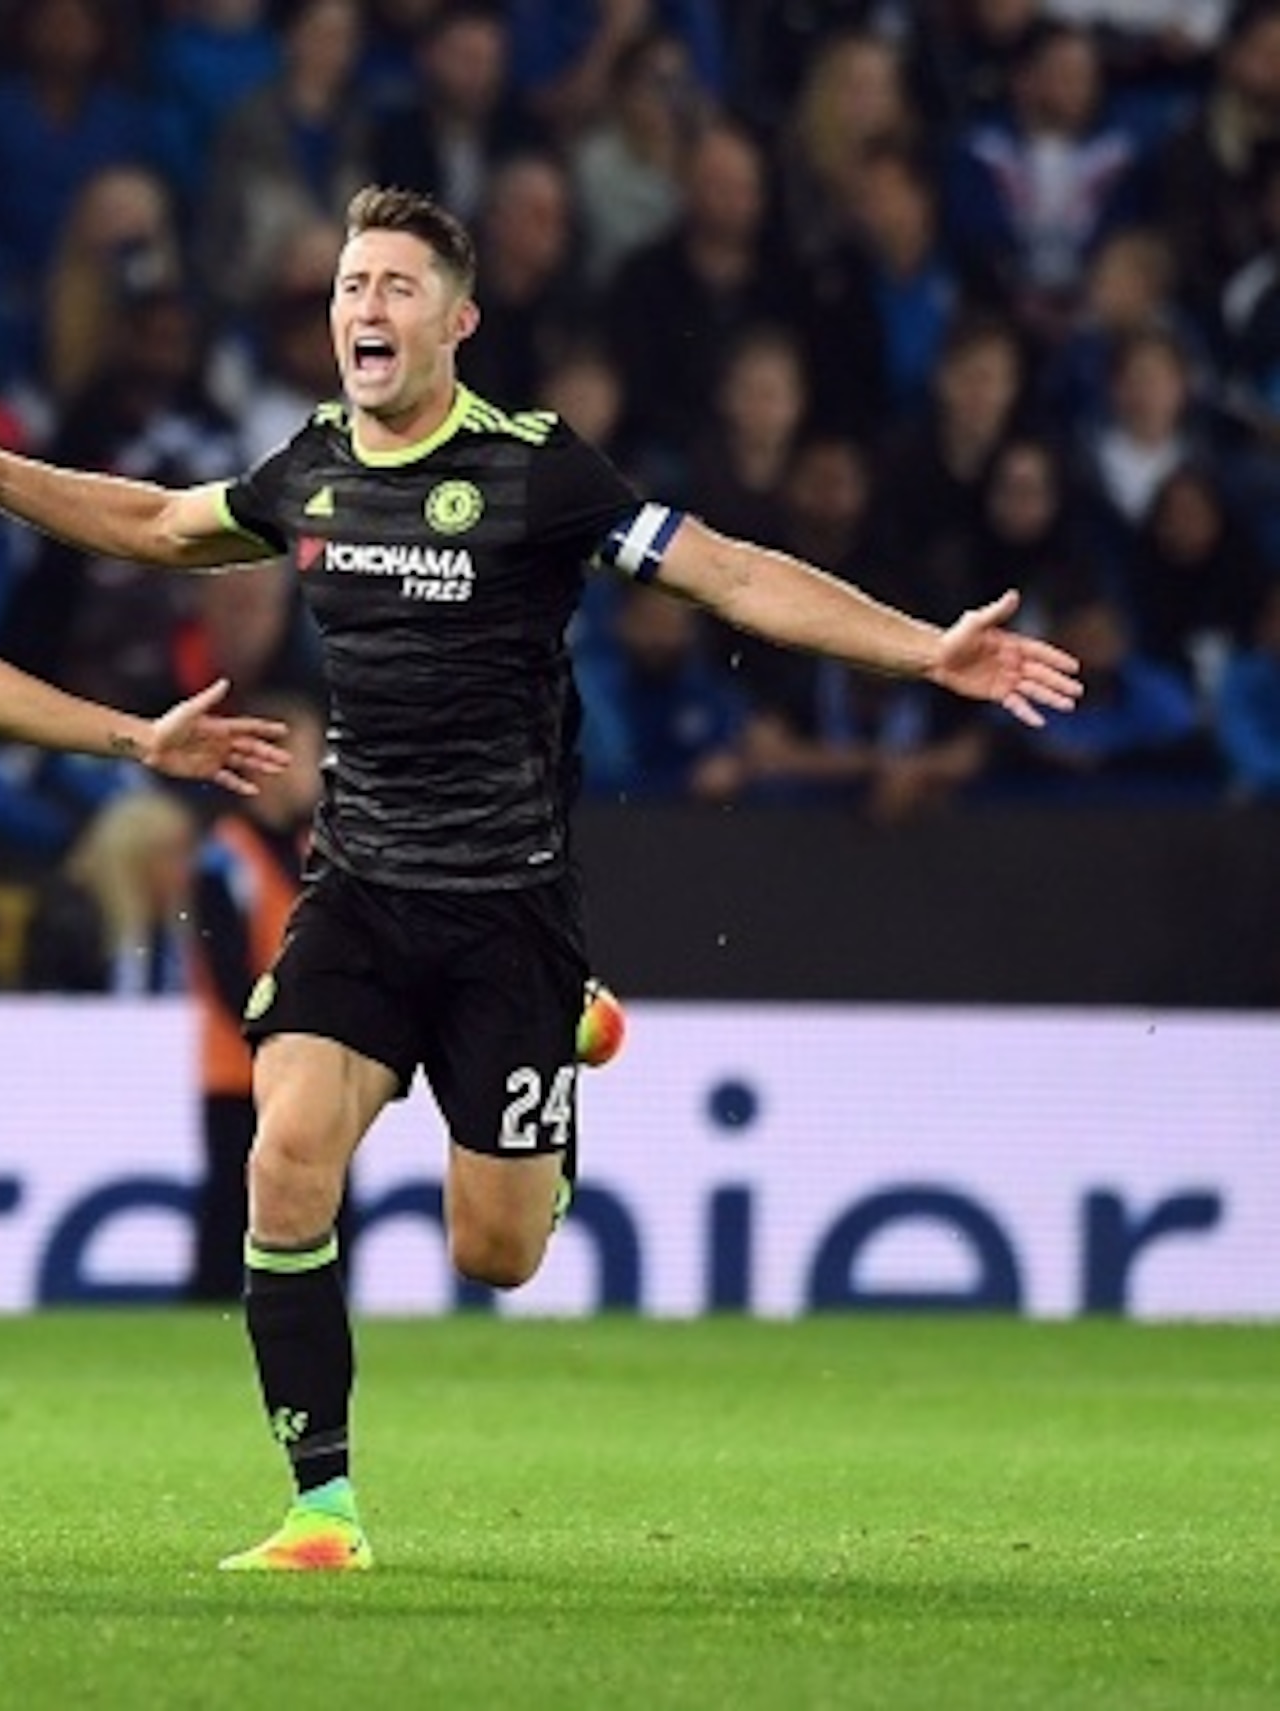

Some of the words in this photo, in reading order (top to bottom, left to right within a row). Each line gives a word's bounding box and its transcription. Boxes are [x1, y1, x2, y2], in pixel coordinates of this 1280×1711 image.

[325, 541, 476, 580] YOKOHAMA
[401, 575, 472, 601] TYRES
[498, 1066, 575, 1150] 24
